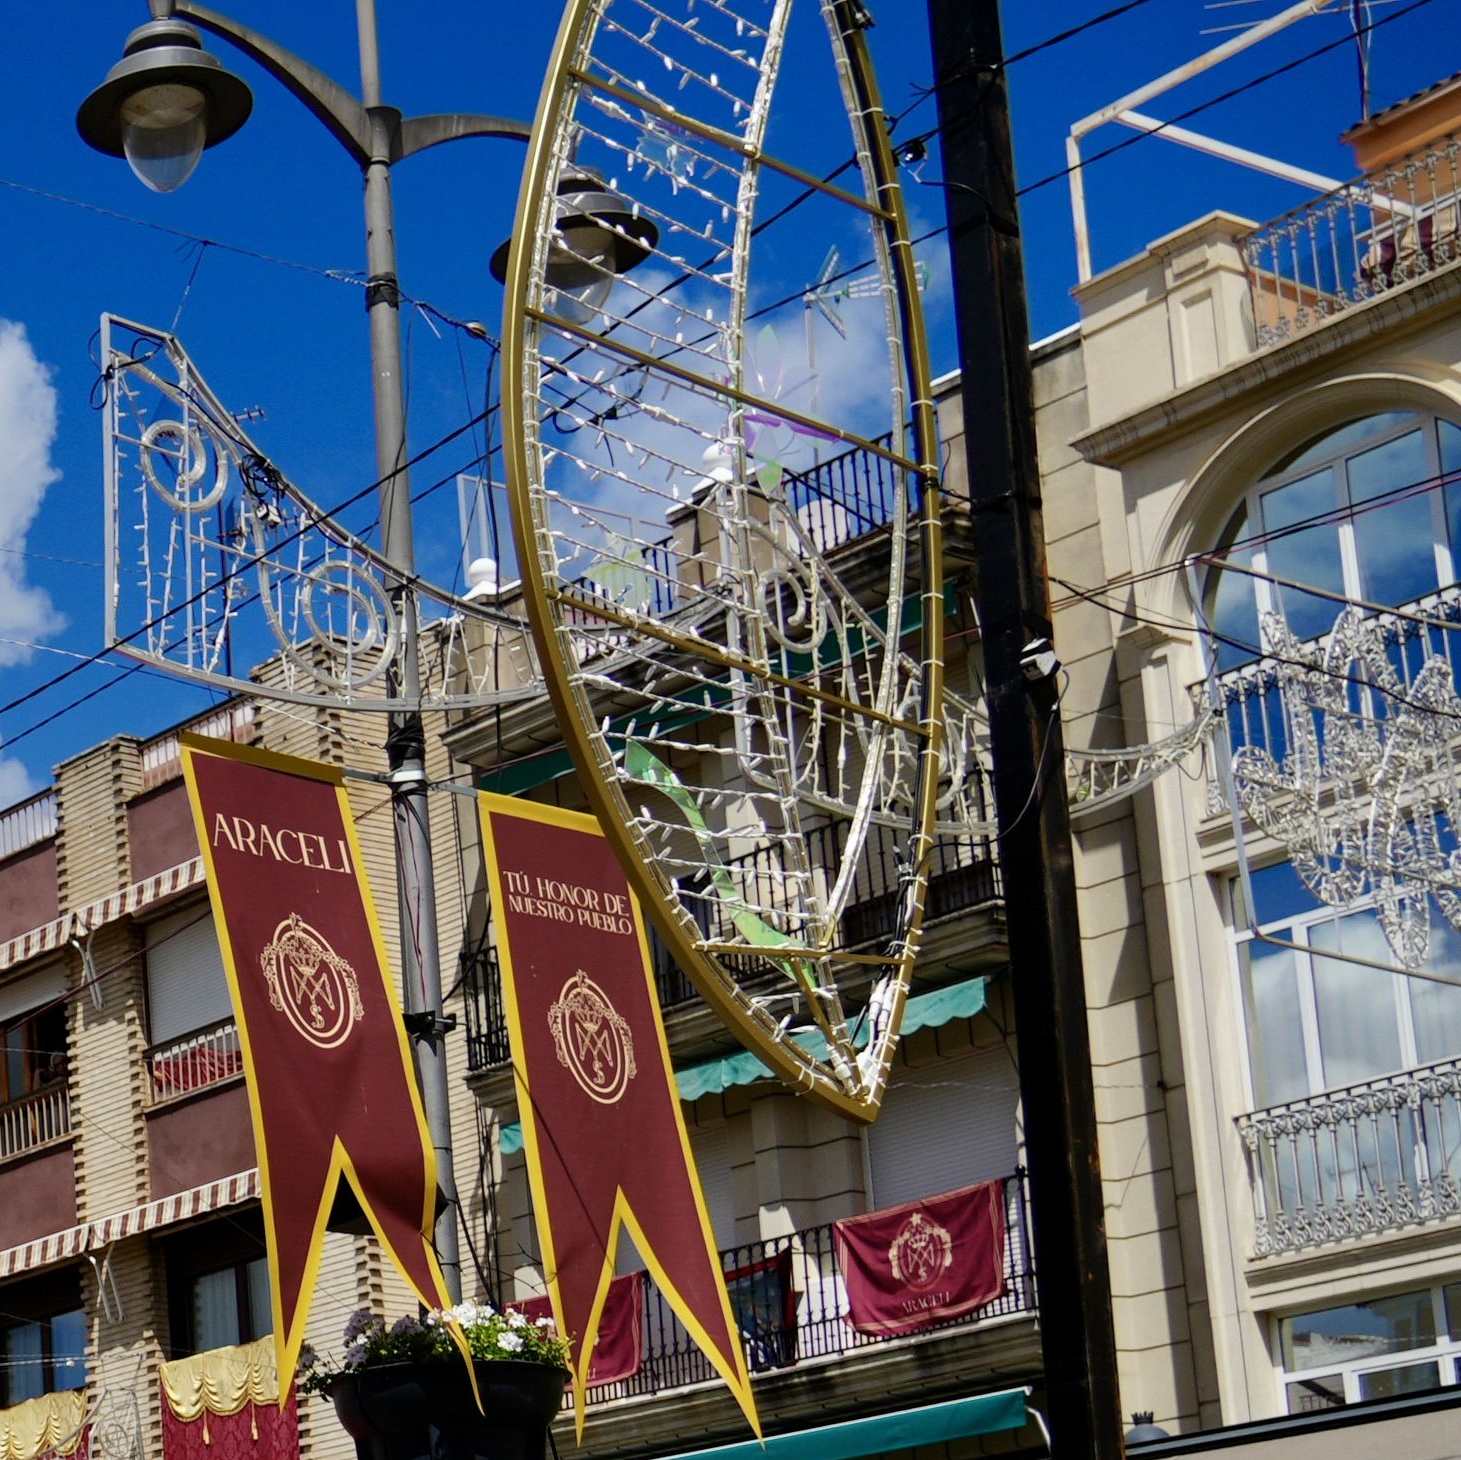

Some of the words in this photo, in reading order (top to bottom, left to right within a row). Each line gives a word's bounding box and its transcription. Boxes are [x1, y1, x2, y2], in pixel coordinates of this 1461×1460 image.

[213, 812, 352, 874] ARACELI
[508, 894, 575, 923] NUESTRO
[577, 908, 633, 936] PUEBLO
[536, 877, 599, 911] HONOR
[603, 892, 630, 917] DE
